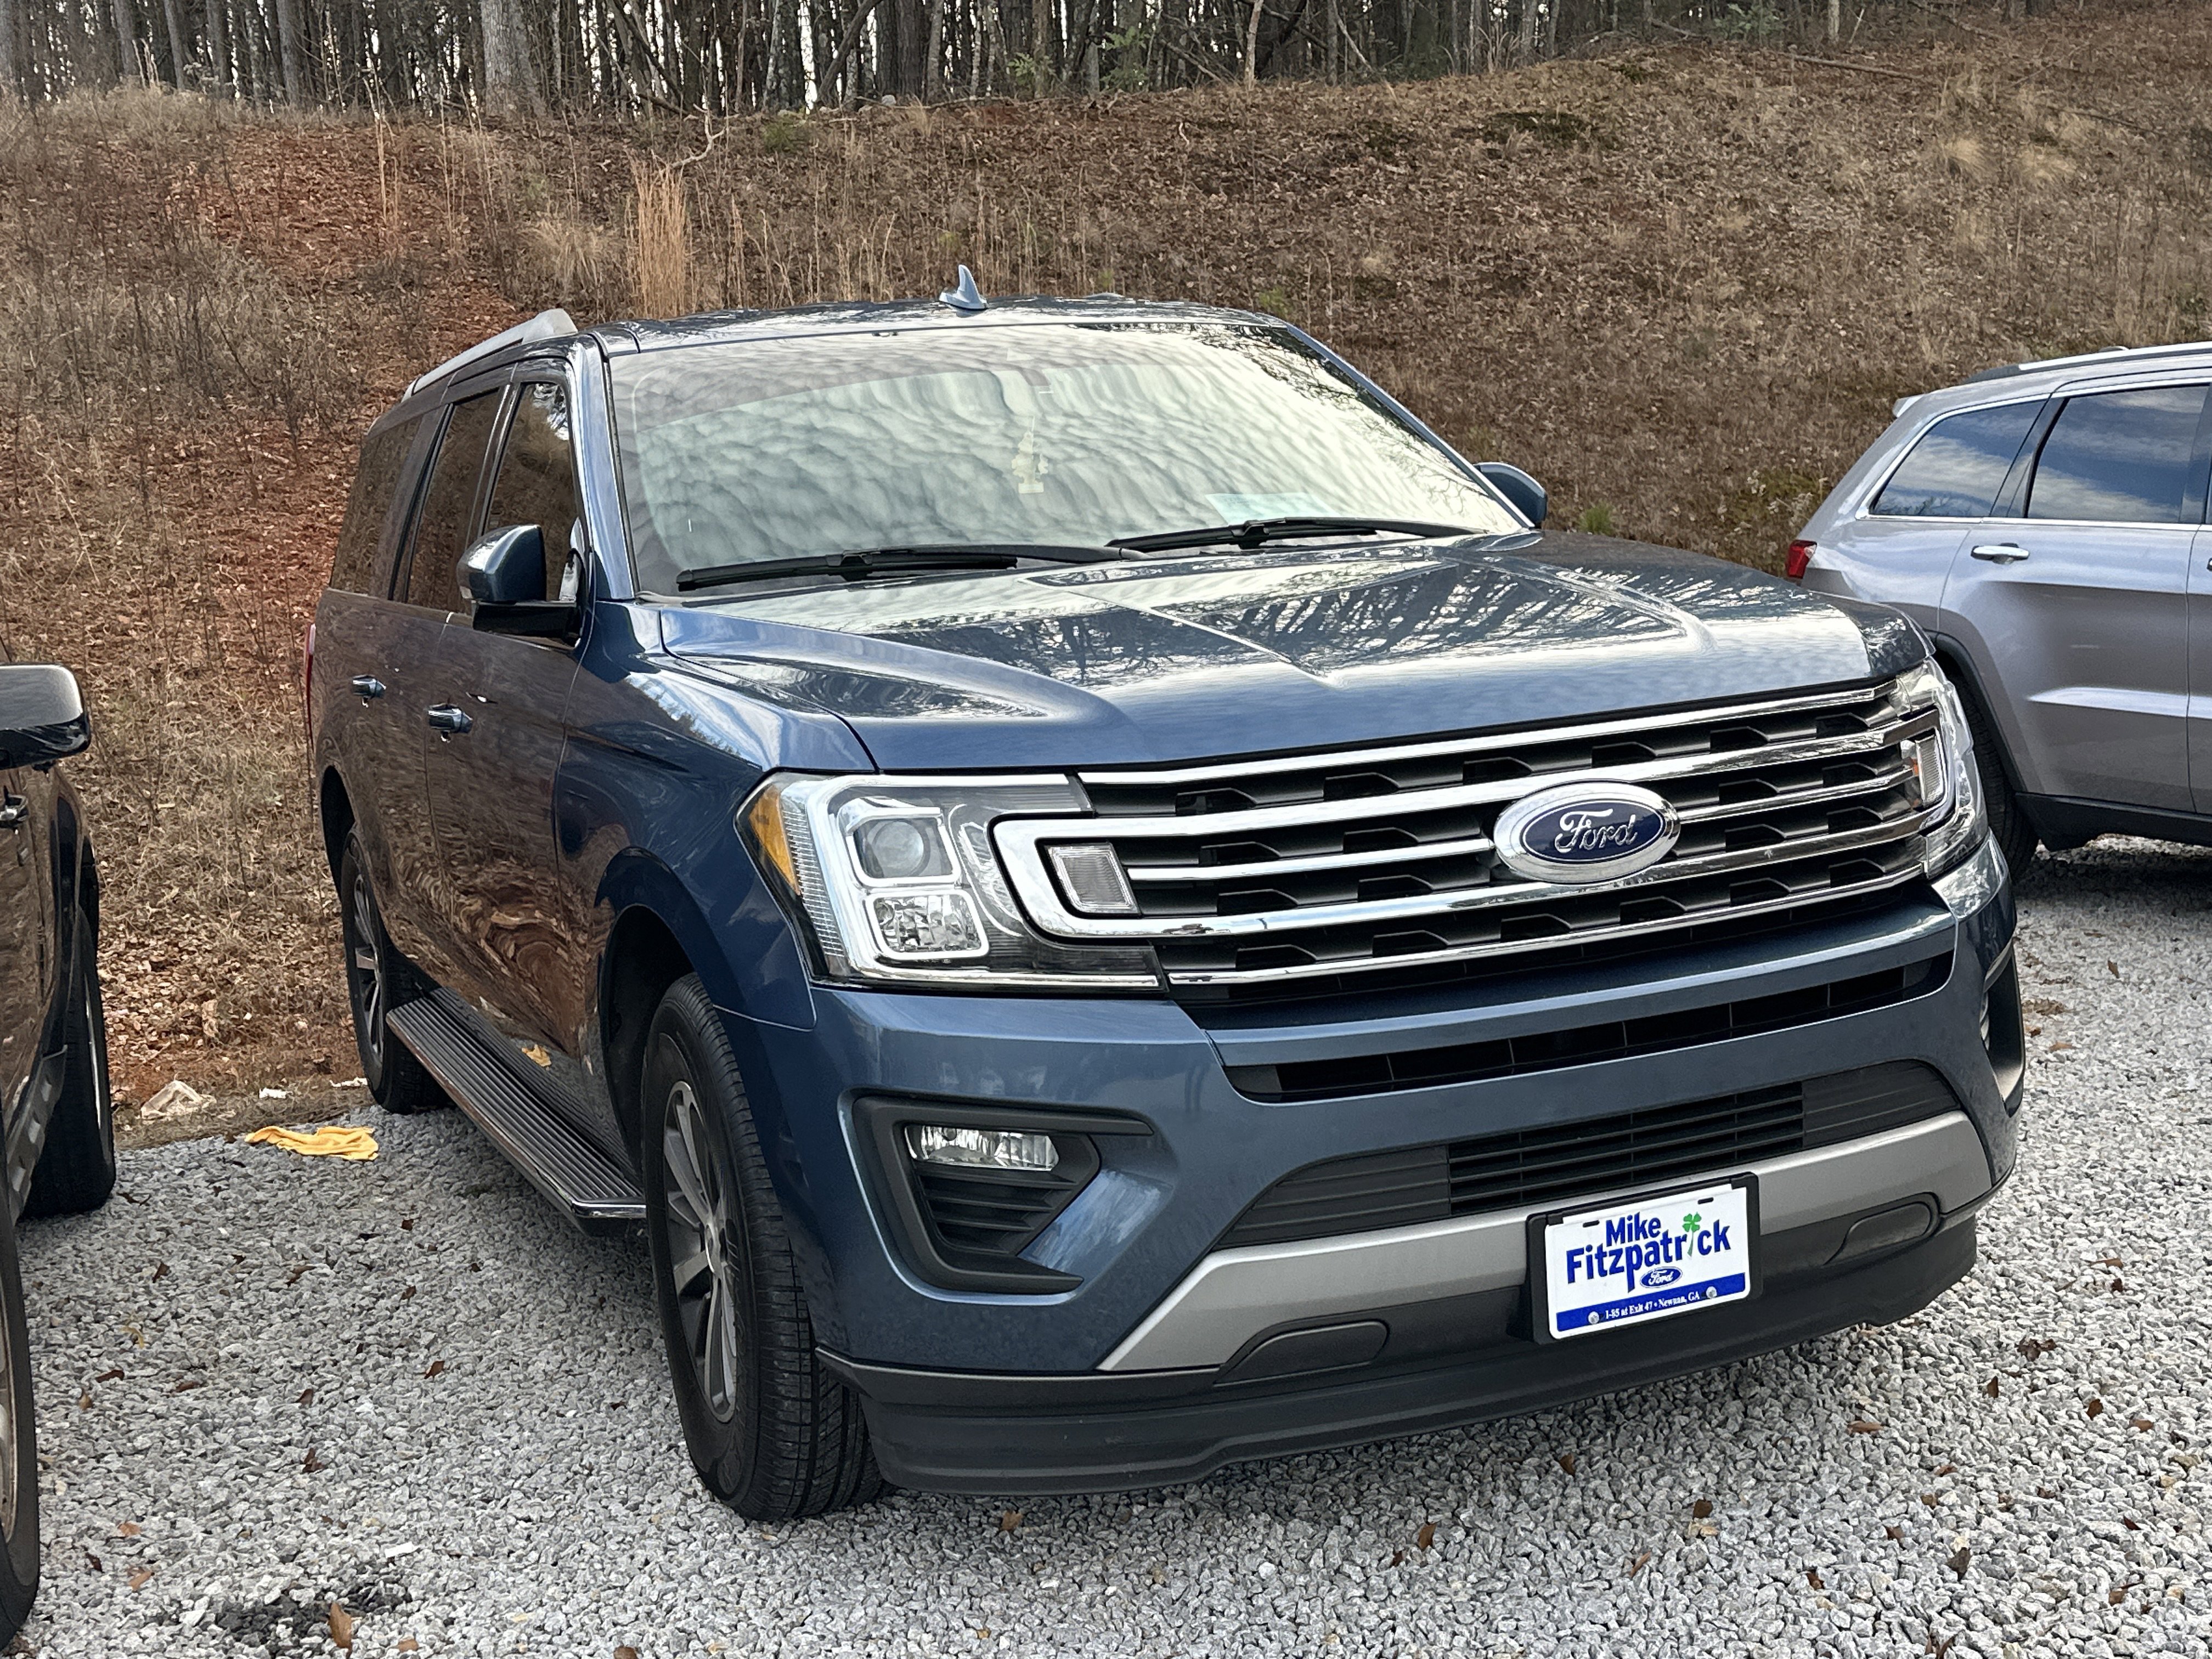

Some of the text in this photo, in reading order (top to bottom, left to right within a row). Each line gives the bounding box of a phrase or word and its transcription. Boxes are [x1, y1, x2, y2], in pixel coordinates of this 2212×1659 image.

[1555, 808, 1638, 853] Ford
[1605, 1211, 1661, 1247] Mike
[1566, 1212, 1731, 1293] Fitzpatrick
[1648, 1269, 1674, 1285] Ford
[1605, 1308, 1620, 1319] I-85
[1621, 1306, 1628, 1316] at
[1629, 1304, 1643, 1314] Exit
[1644, 1301, 1653, 1311] 47
[1688, 1291, 1700, 1301] GA
